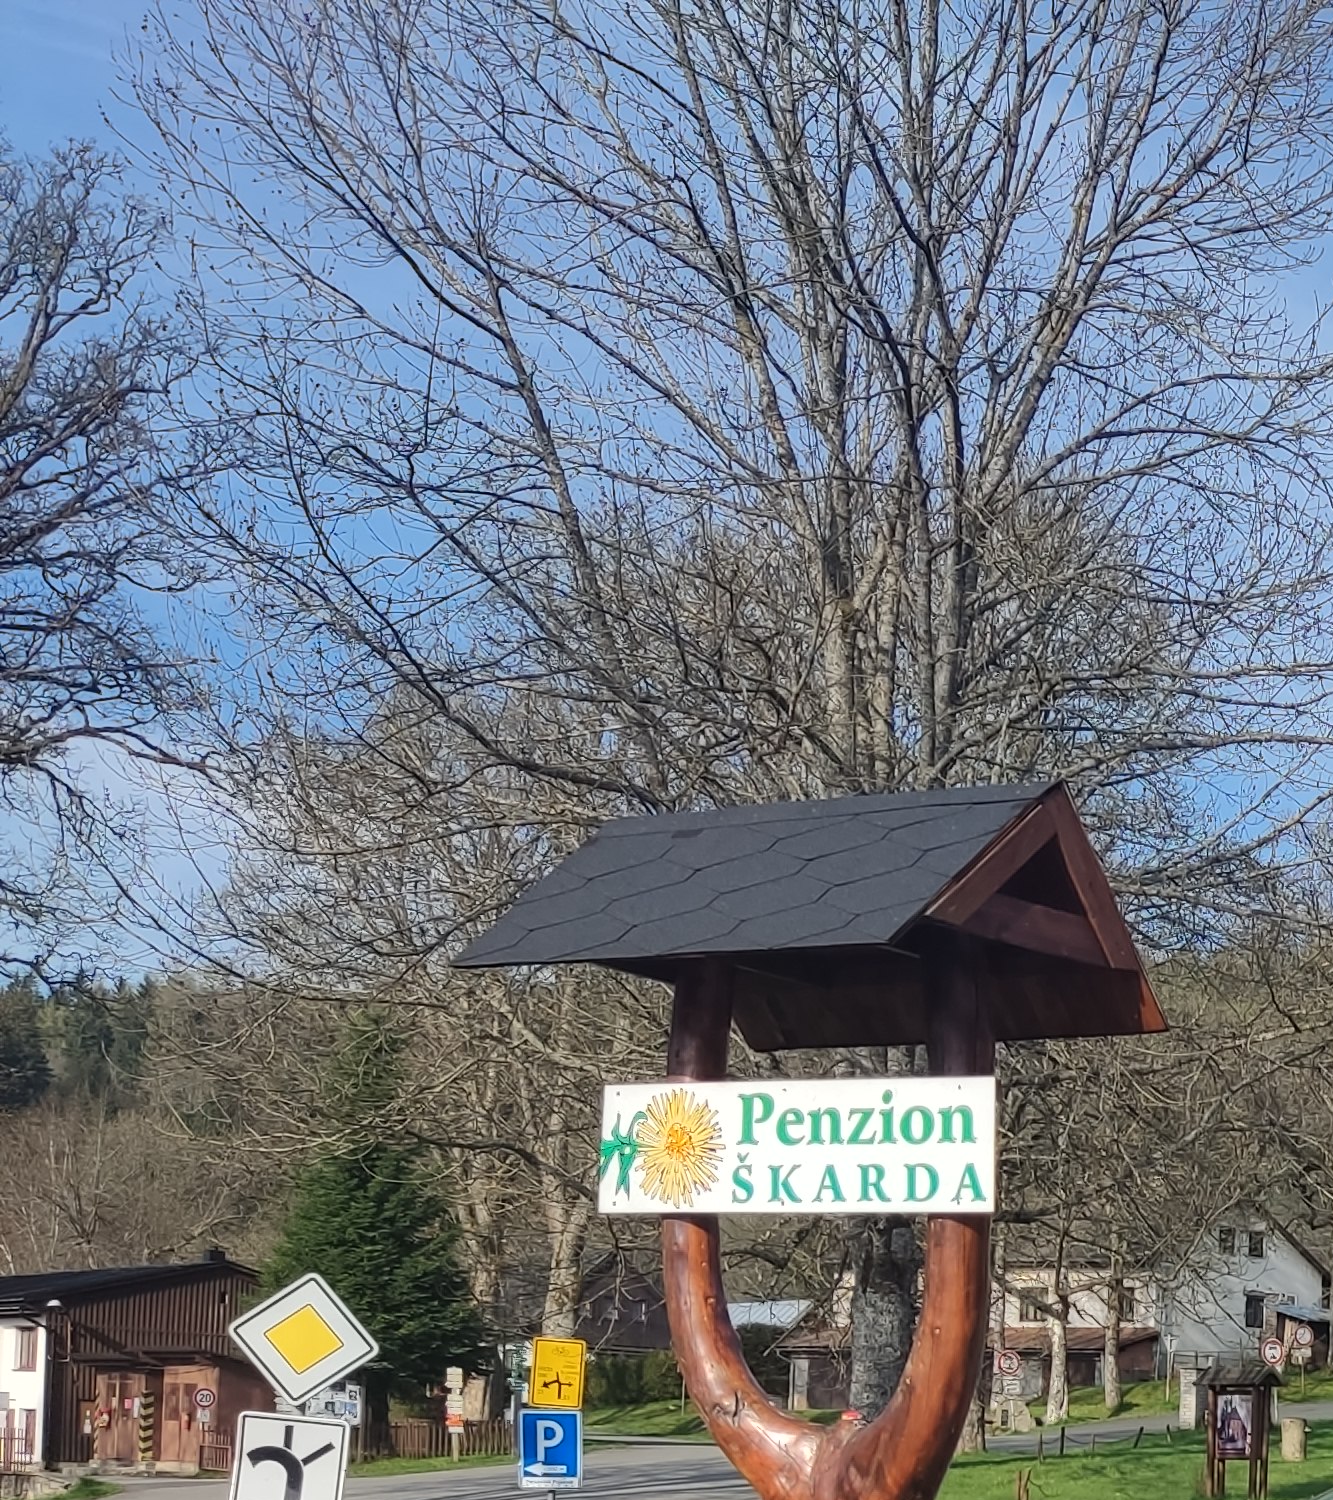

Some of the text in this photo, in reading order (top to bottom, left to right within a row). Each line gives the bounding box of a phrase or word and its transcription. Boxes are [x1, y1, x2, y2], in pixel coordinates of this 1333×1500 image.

[736, 1089, 978, 1146] Penzion
[732, 1152, 987, 1204] ŠKARDA
[199, 1393, 211, 1403] 20
[536, 1420, 564, 1462] P
